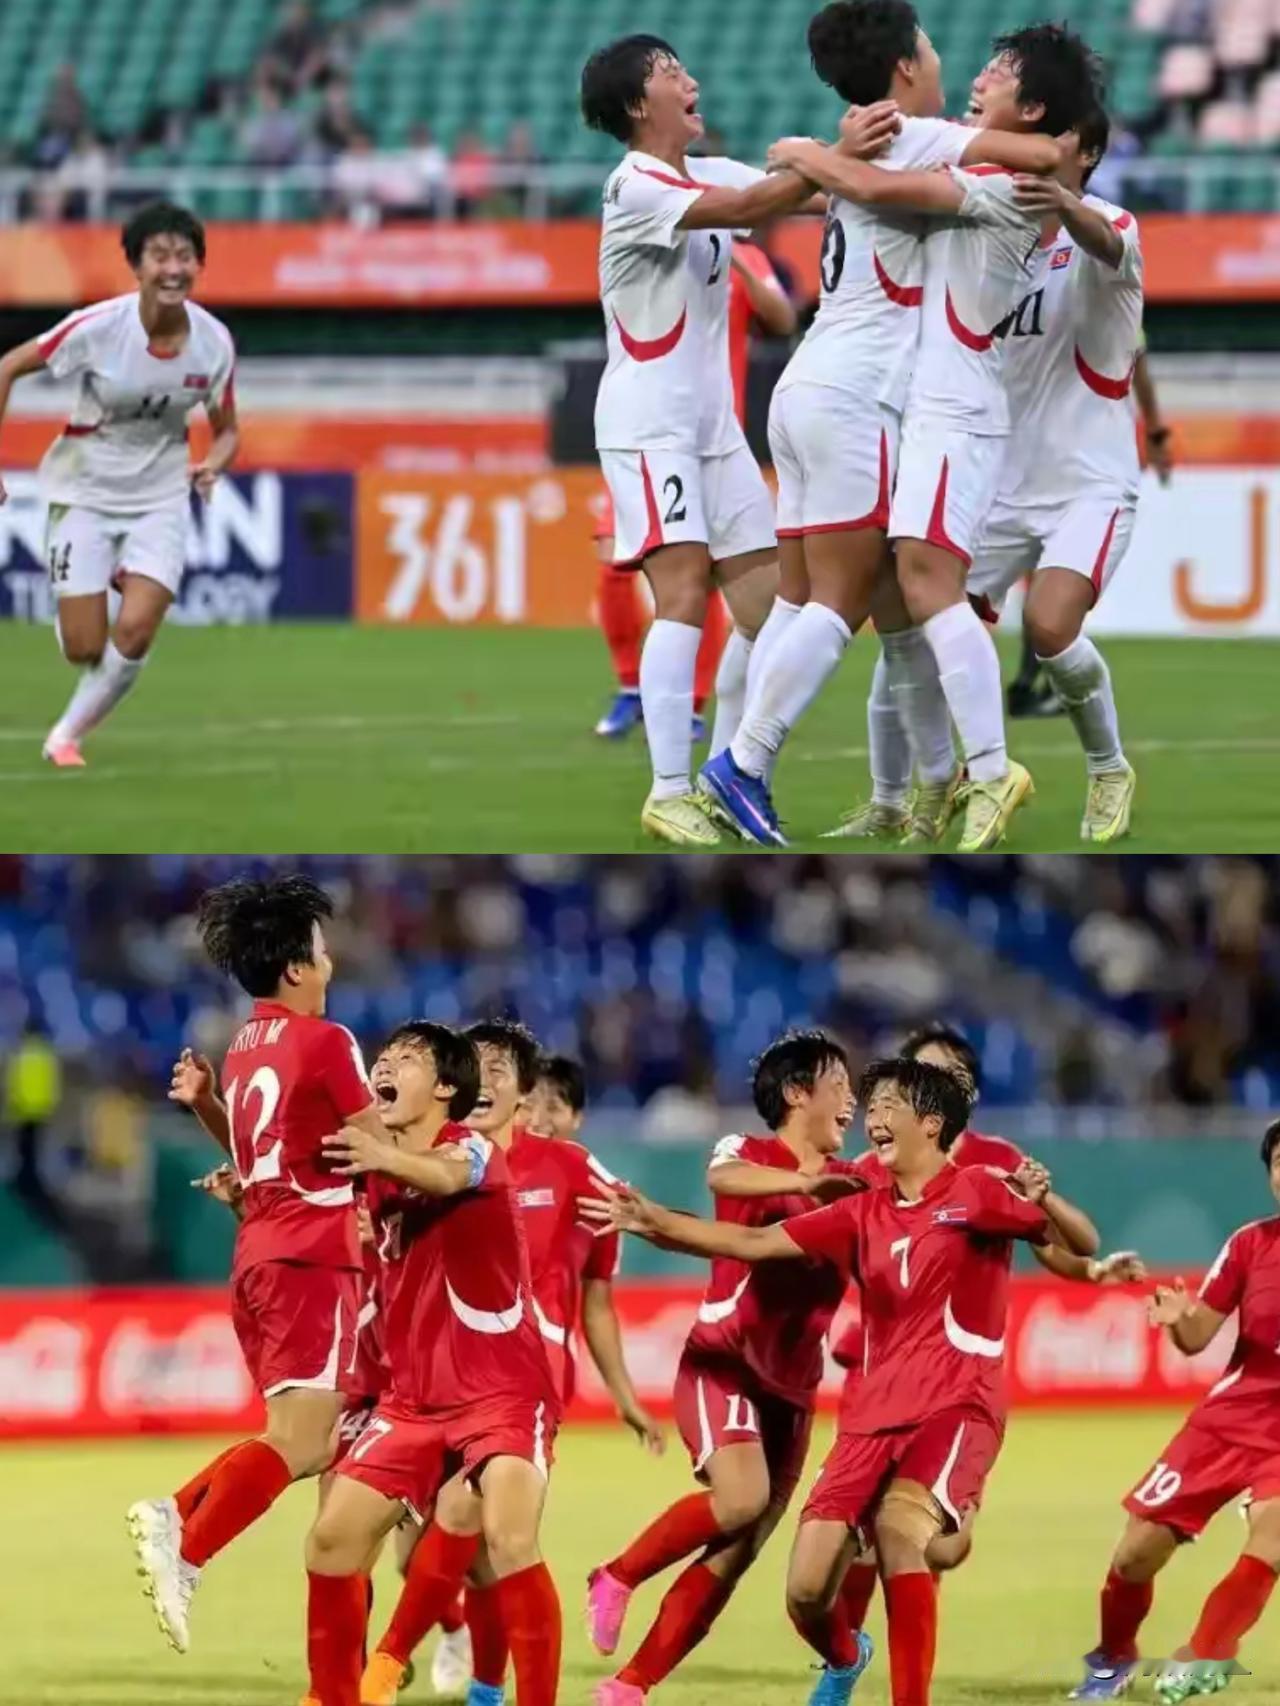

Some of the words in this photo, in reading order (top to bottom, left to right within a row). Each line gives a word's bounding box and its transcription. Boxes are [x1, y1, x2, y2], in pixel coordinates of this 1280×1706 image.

[663, 474, 687, 524] 2
[50, 541, 72, 583] 14
[1173, 487, 1267, 622] J
[225, 1066, 283, 1189] 12
[890, 1236, 911, 1288] 7
[722, 1394, 760, 1433] 11
[1134, 1463, 1182, 1506] 19
